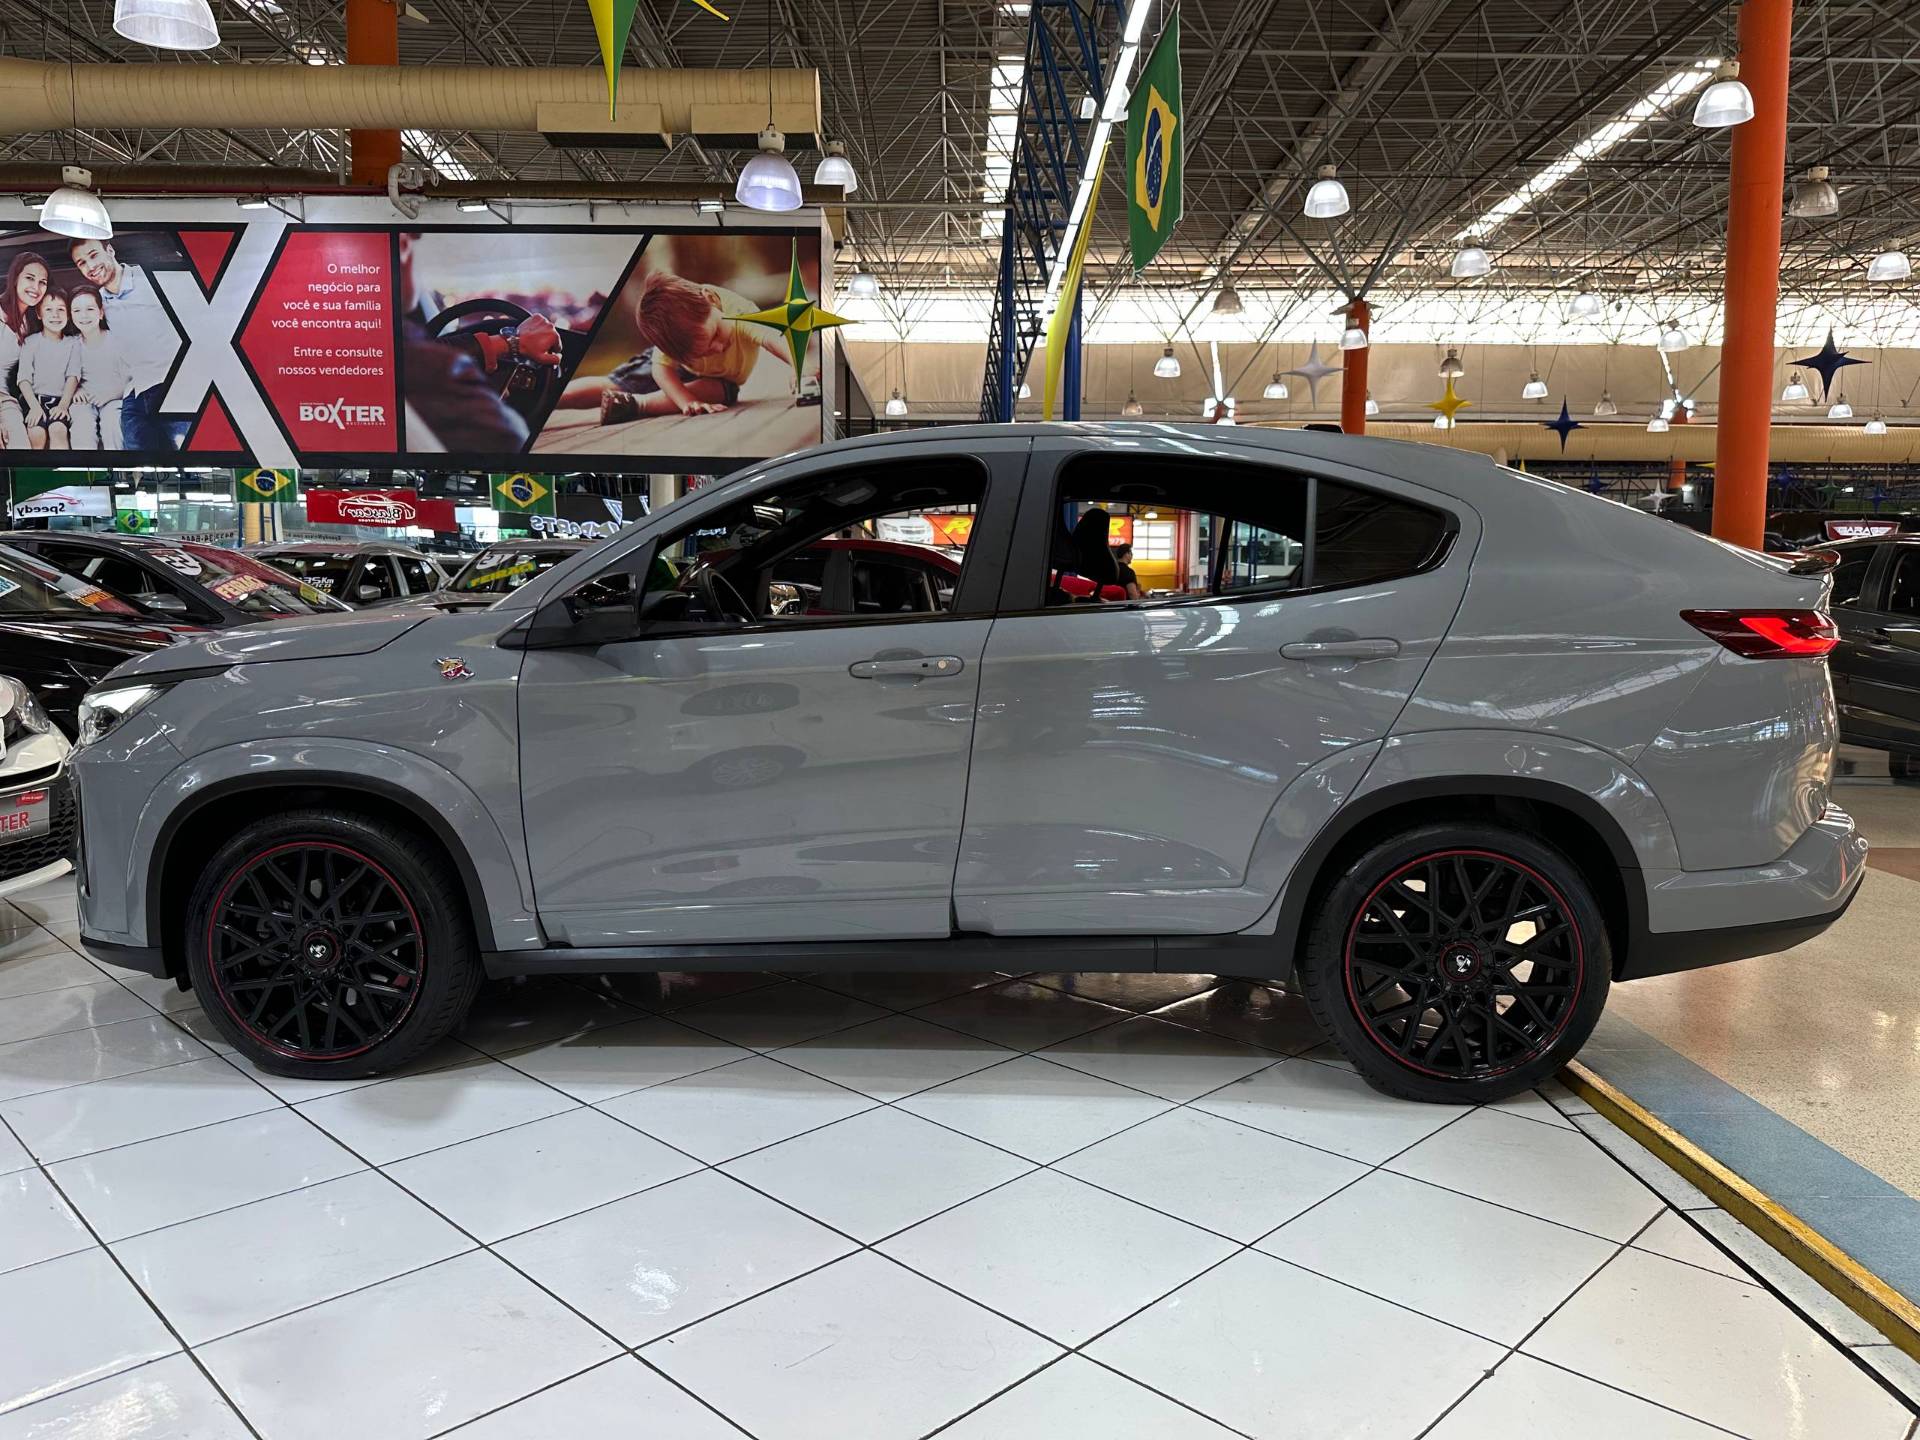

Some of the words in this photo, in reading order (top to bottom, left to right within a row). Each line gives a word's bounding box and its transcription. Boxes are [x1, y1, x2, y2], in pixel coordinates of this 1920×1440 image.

[327, 263, 337, 275] O
[340, 263, 381, 275] melhor
[307, 281, 354, 295] negócio
[356, 285, 381, 294] para
[283, 300, 311, 311] você
[313, 302, 320, 311] e
[322, 302, 342, 311] sua
[344, 300, 382, 311] família
[271, 318, 299, 329] você
[301, 319, 352, 329] encontra
[354, 319, 382, 331] aqui!
[293, 346, 323, 357] Entre
[325, 348, 333, 357] e
[335, 347, 383, 358] consulte
[278, 366, 317, 375] nossos
[319, 365, 384, 376] vendedores
[299, 397, 385, 430] BOXTER
